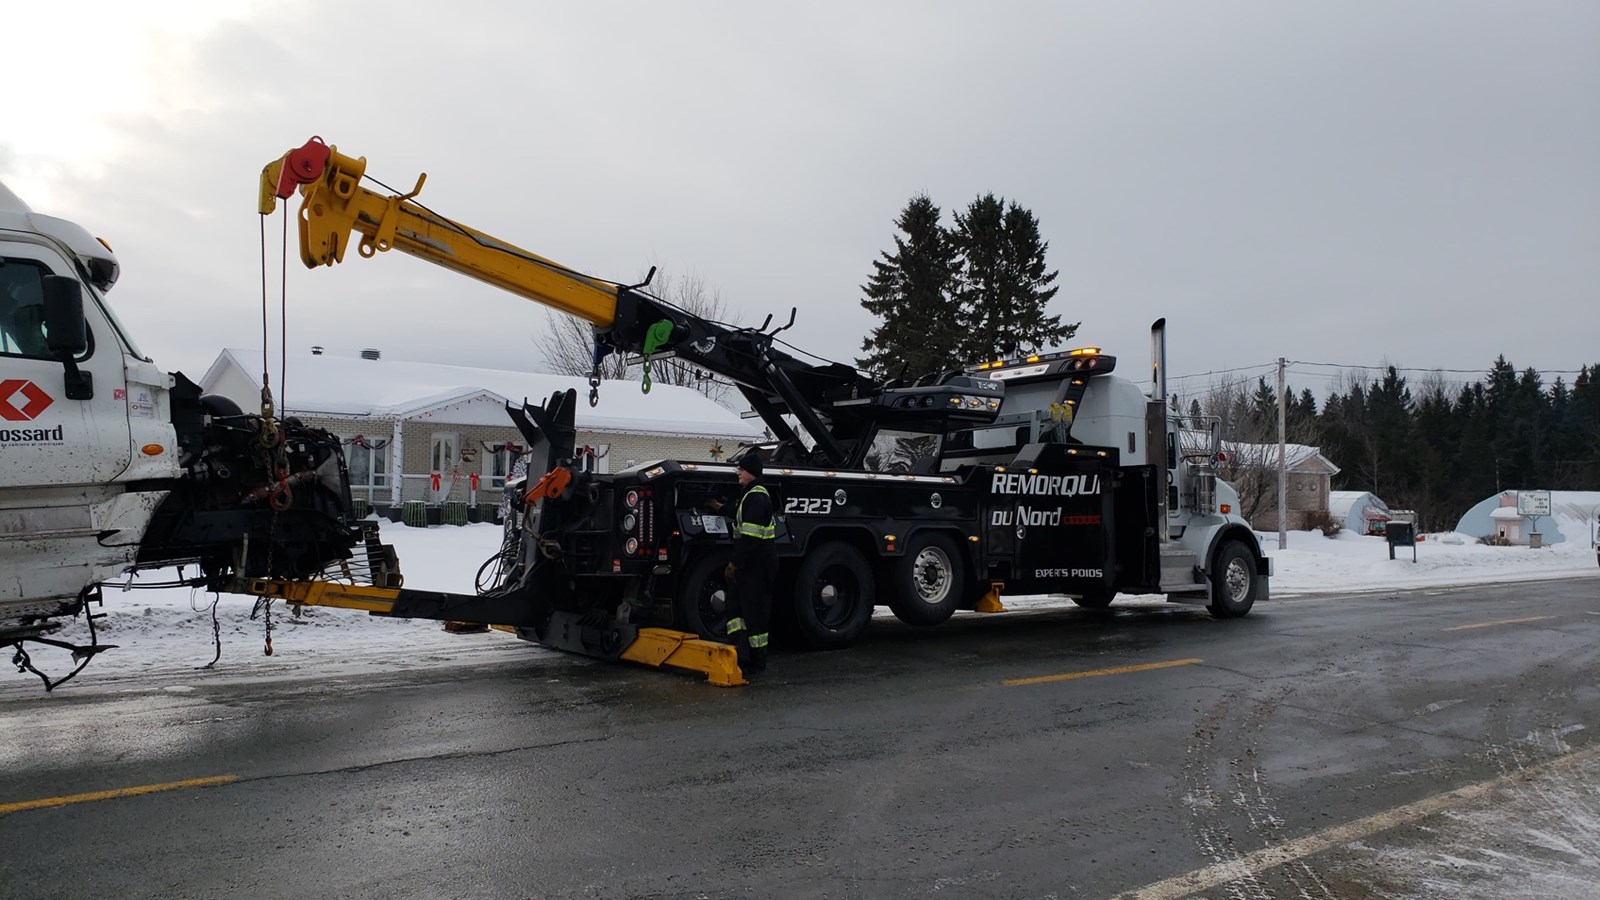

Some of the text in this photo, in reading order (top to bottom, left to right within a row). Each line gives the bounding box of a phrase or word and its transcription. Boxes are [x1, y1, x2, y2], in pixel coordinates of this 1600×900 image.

[784, 497, 833, 514] 2323
[1016, 506, 1062, 526] Nord
[1071, 568, 1103, 578] POIDS
